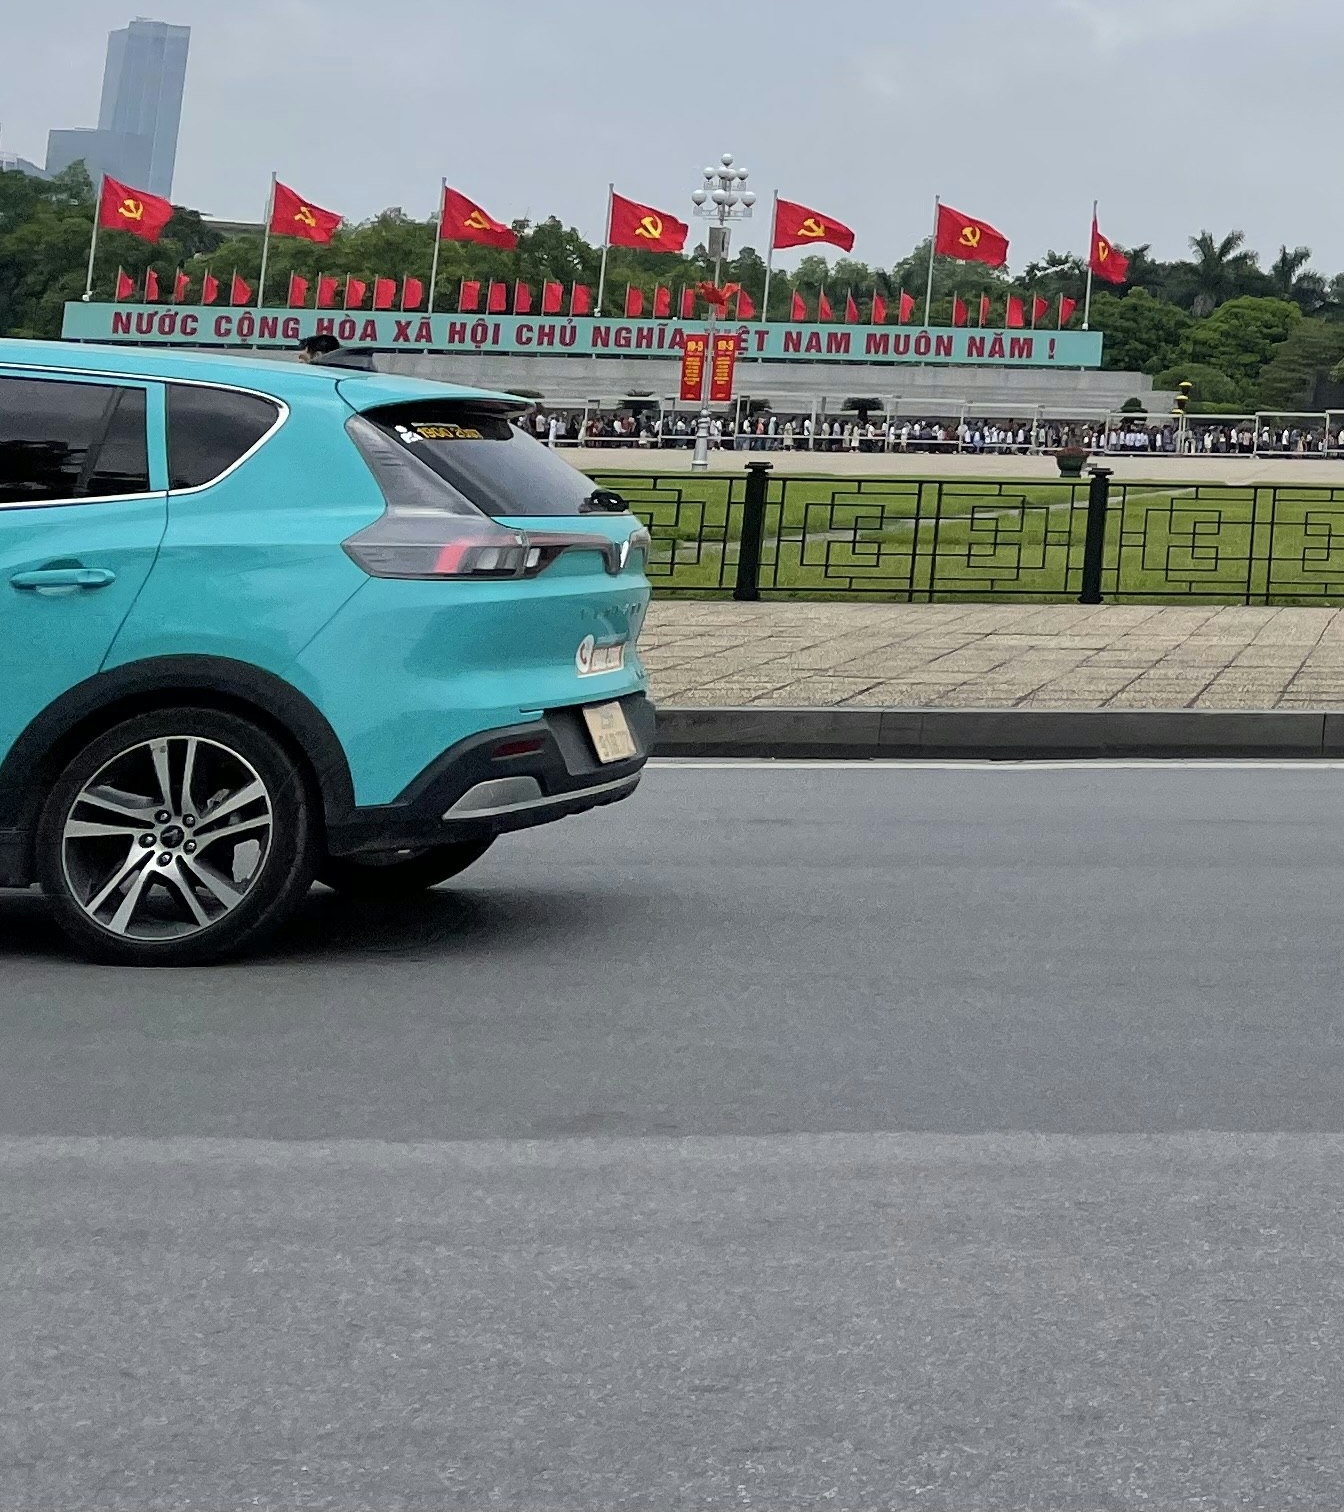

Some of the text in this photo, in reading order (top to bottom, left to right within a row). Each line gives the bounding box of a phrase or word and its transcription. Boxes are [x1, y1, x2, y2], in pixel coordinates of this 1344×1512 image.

[111, 308, 1056, 360] NƯỚC CỘNG HÒA XÃ HỘI CHỦ NGHĨA ỆT NAM MUÔN NĂM !
